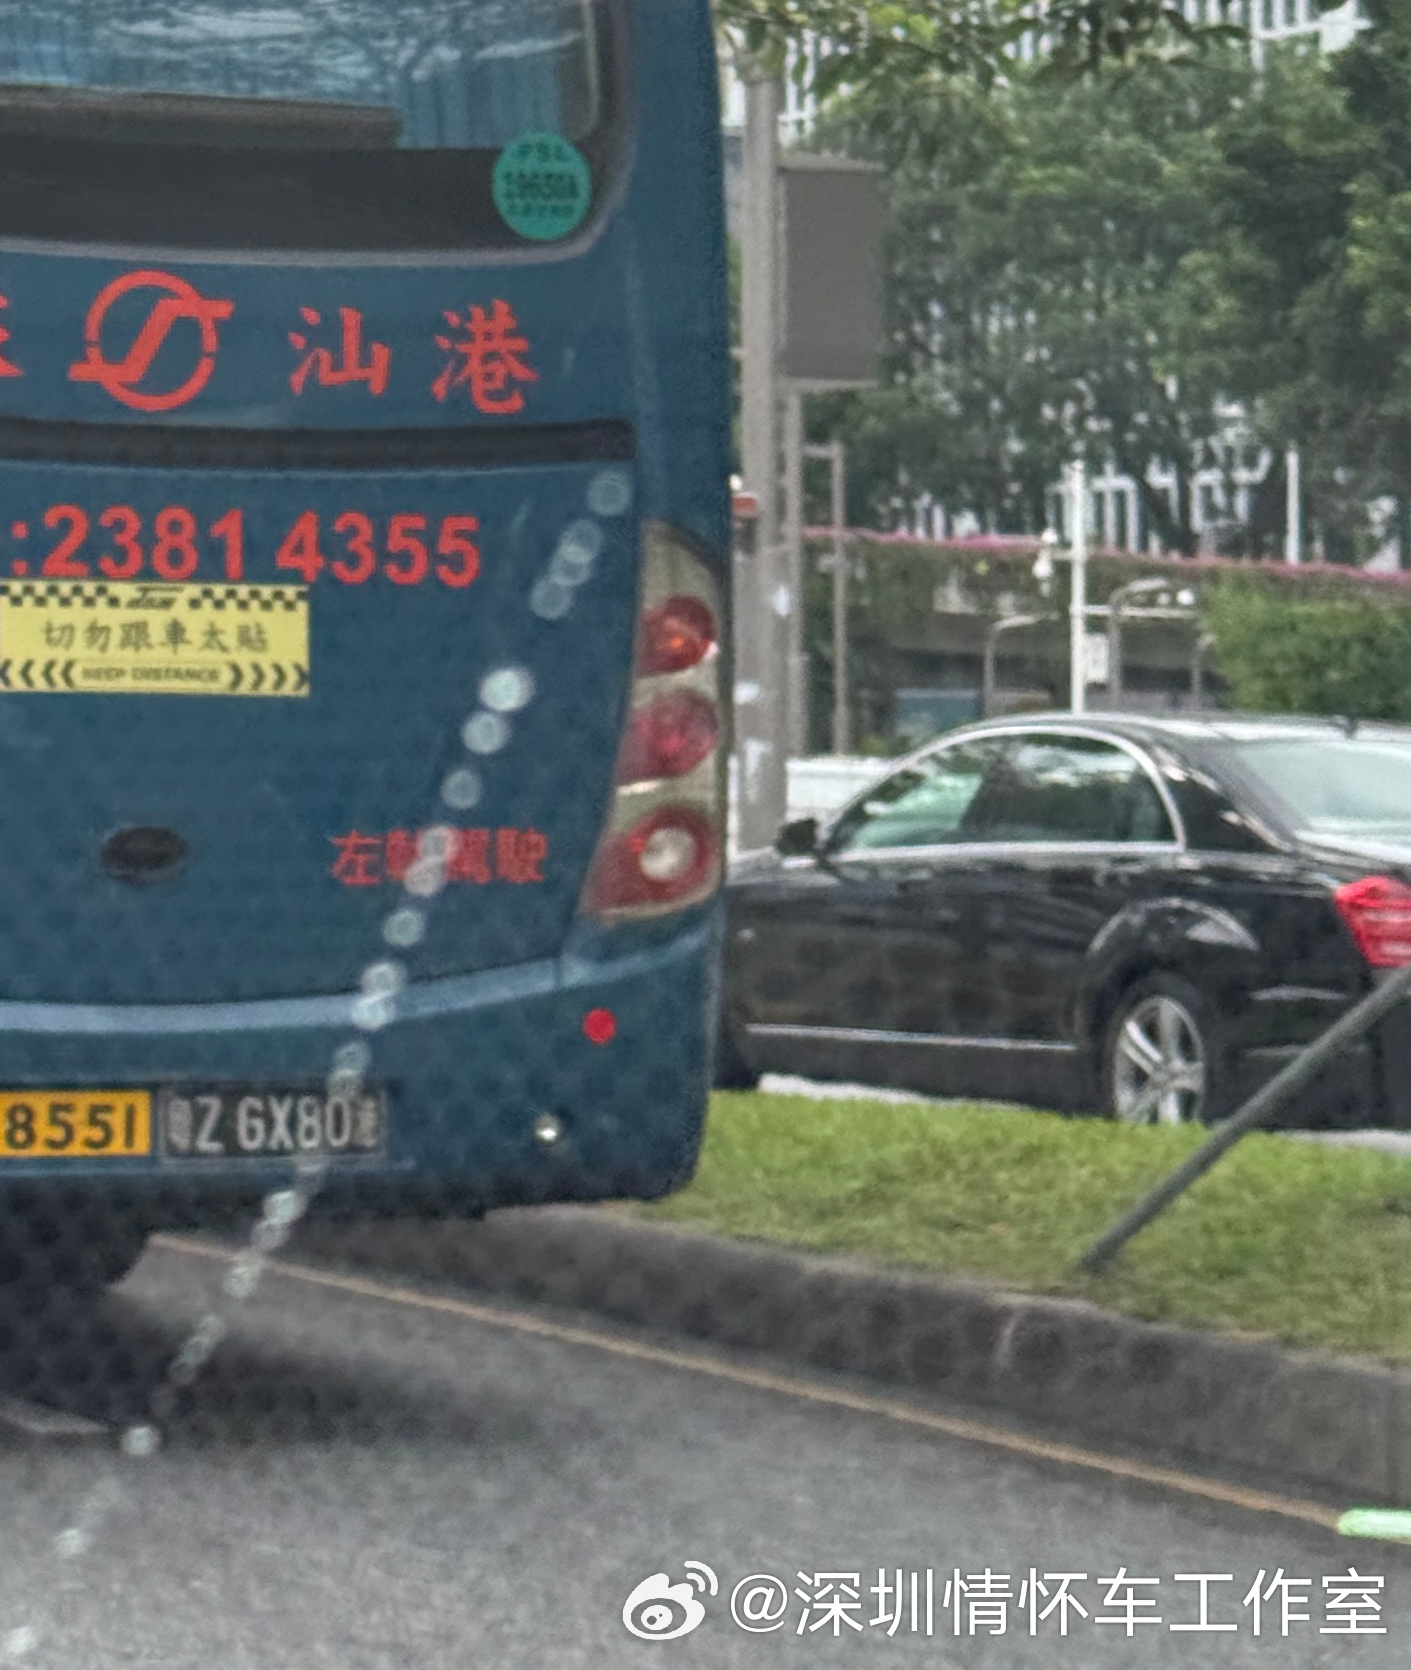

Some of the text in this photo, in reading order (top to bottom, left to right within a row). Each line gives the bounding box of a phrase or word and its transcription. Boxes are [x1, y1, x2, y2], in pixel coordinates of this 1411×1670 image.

[287, 298, 541, 414] 汕港
[44, 618, 269, 654] 切勿跟車太貼
[4, 1101, 138, 1150] 8551
